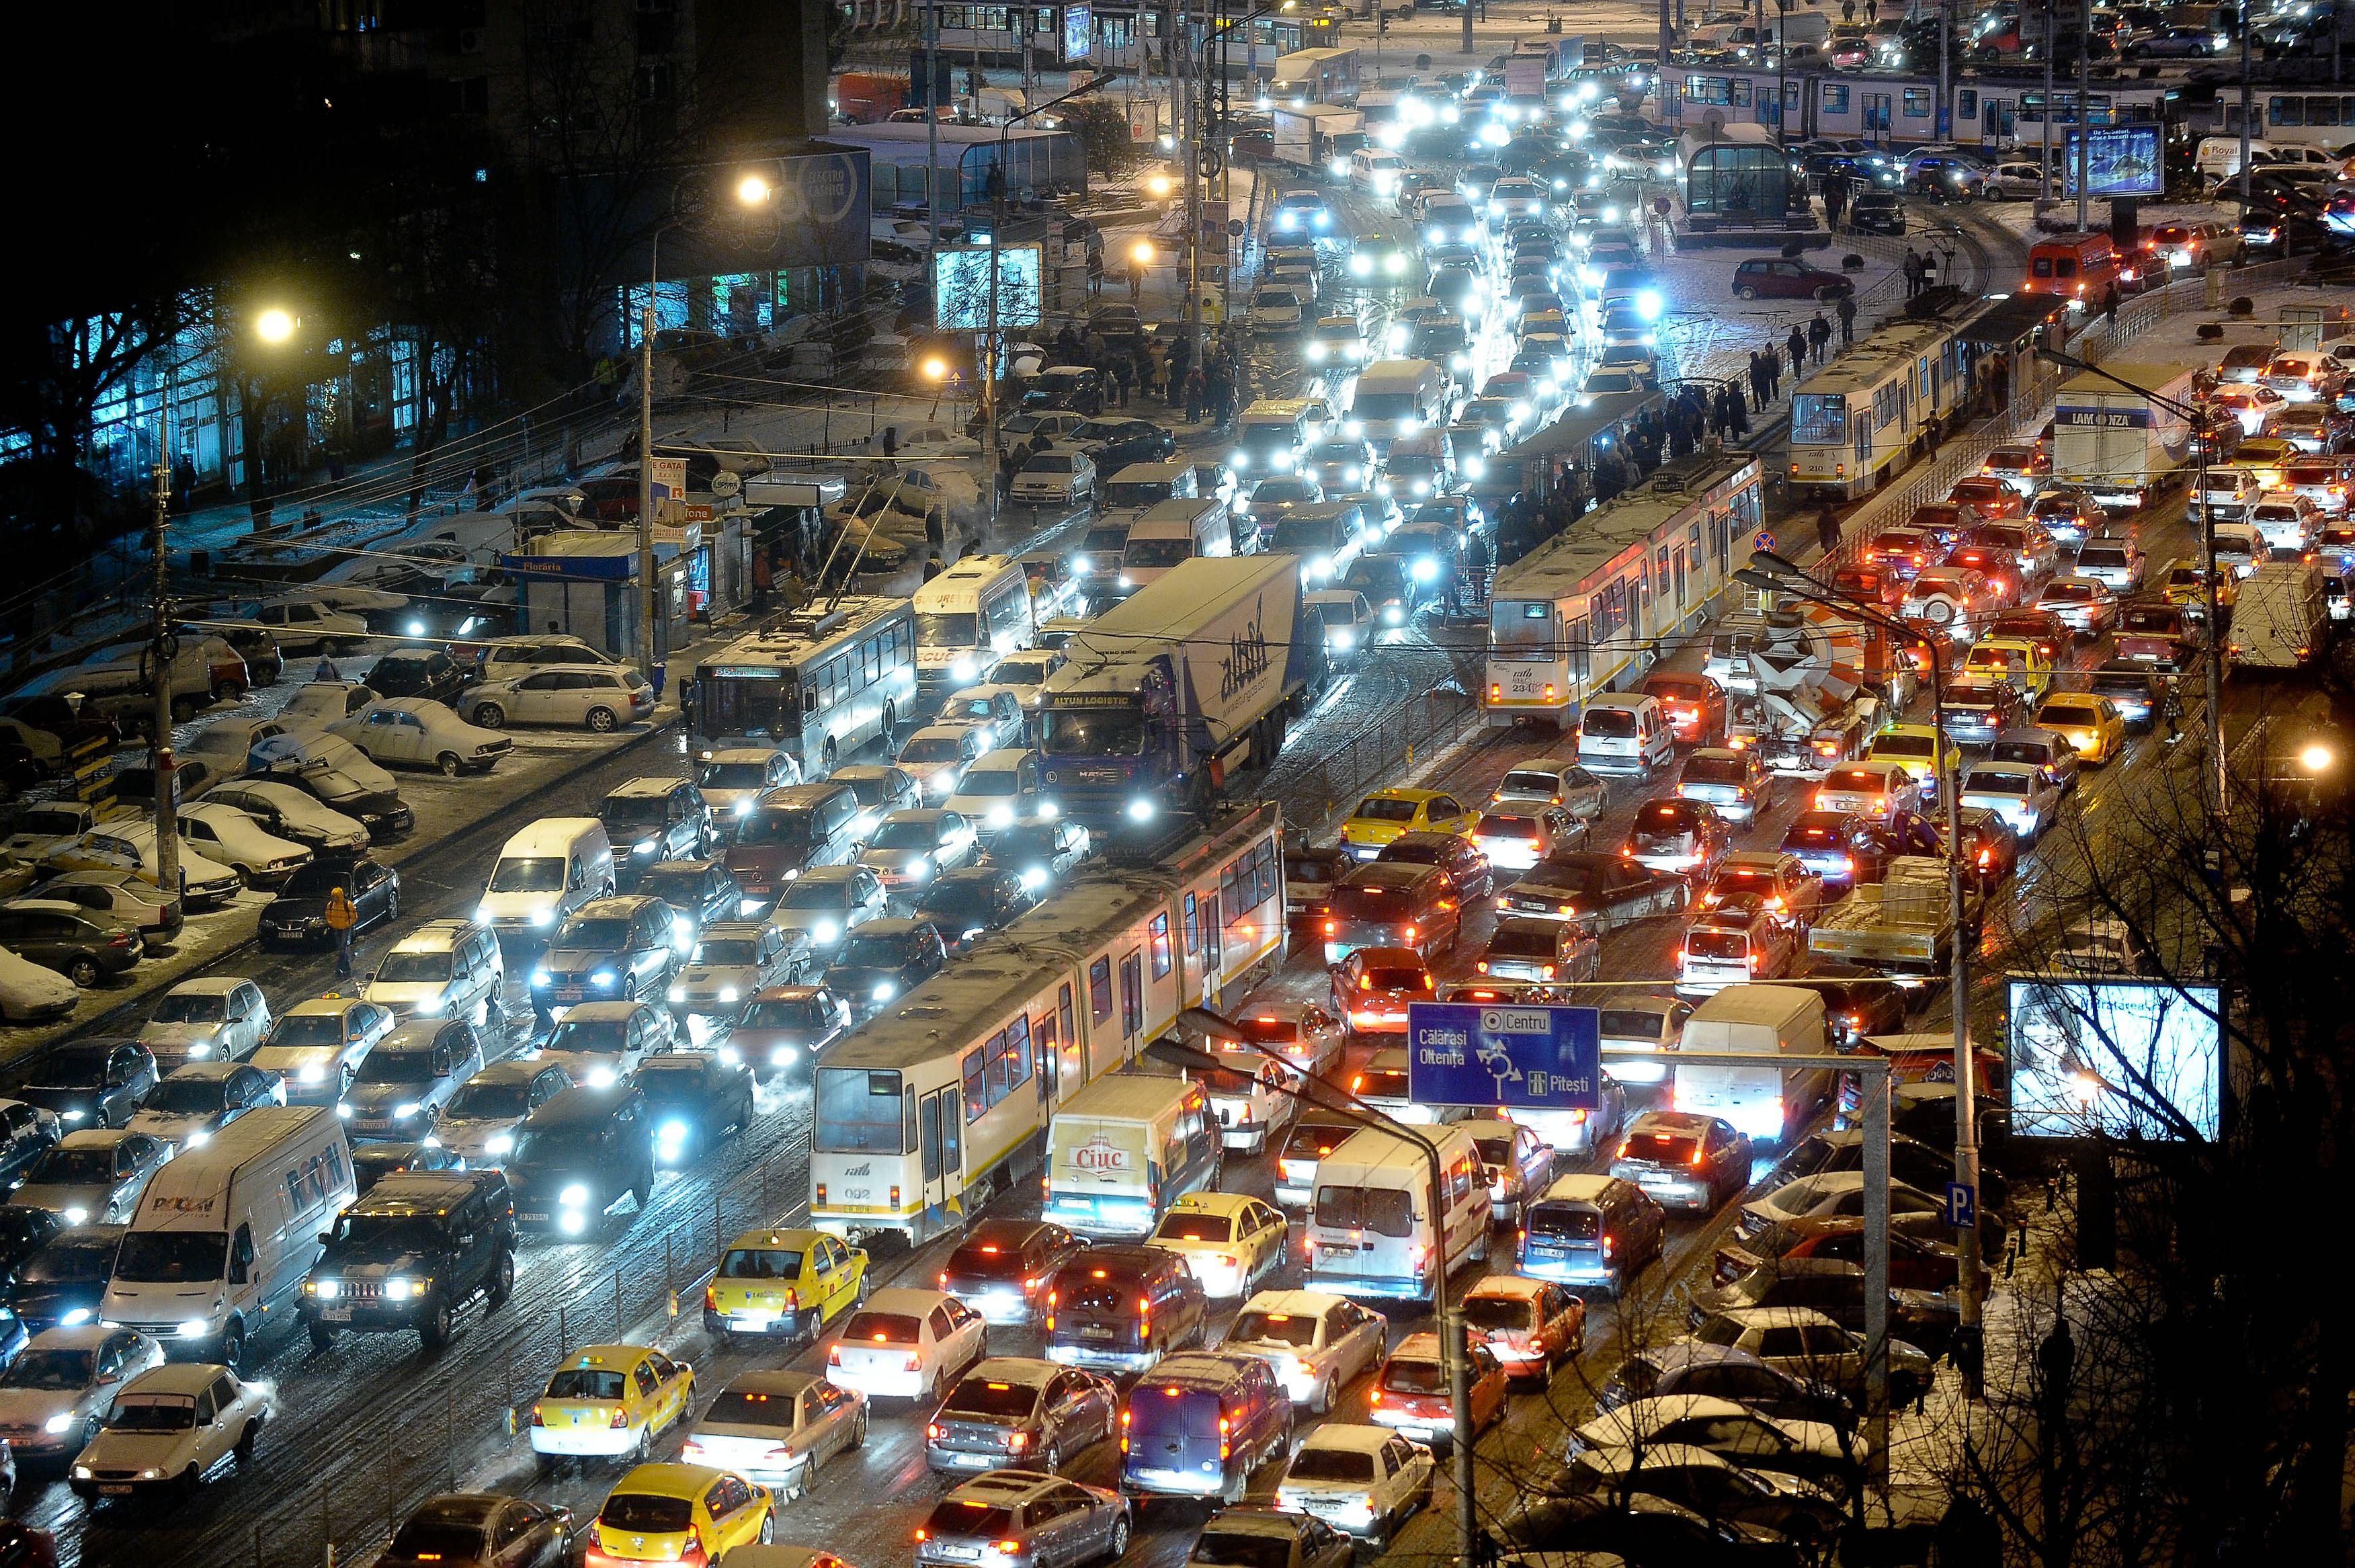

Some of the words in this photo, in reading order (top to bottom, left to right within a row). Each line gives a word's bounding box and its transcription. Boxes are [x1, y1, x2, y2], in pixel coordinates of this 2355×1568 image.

[2212, 146, 2237, 155] Royal
[1505, 1014, 1547, 1030] Centru
[1077, 1149, 1122, 1168] Ciuc
[845, 1188, 871, 1199] 092
[1952, 1187, 1967, 1222] P
